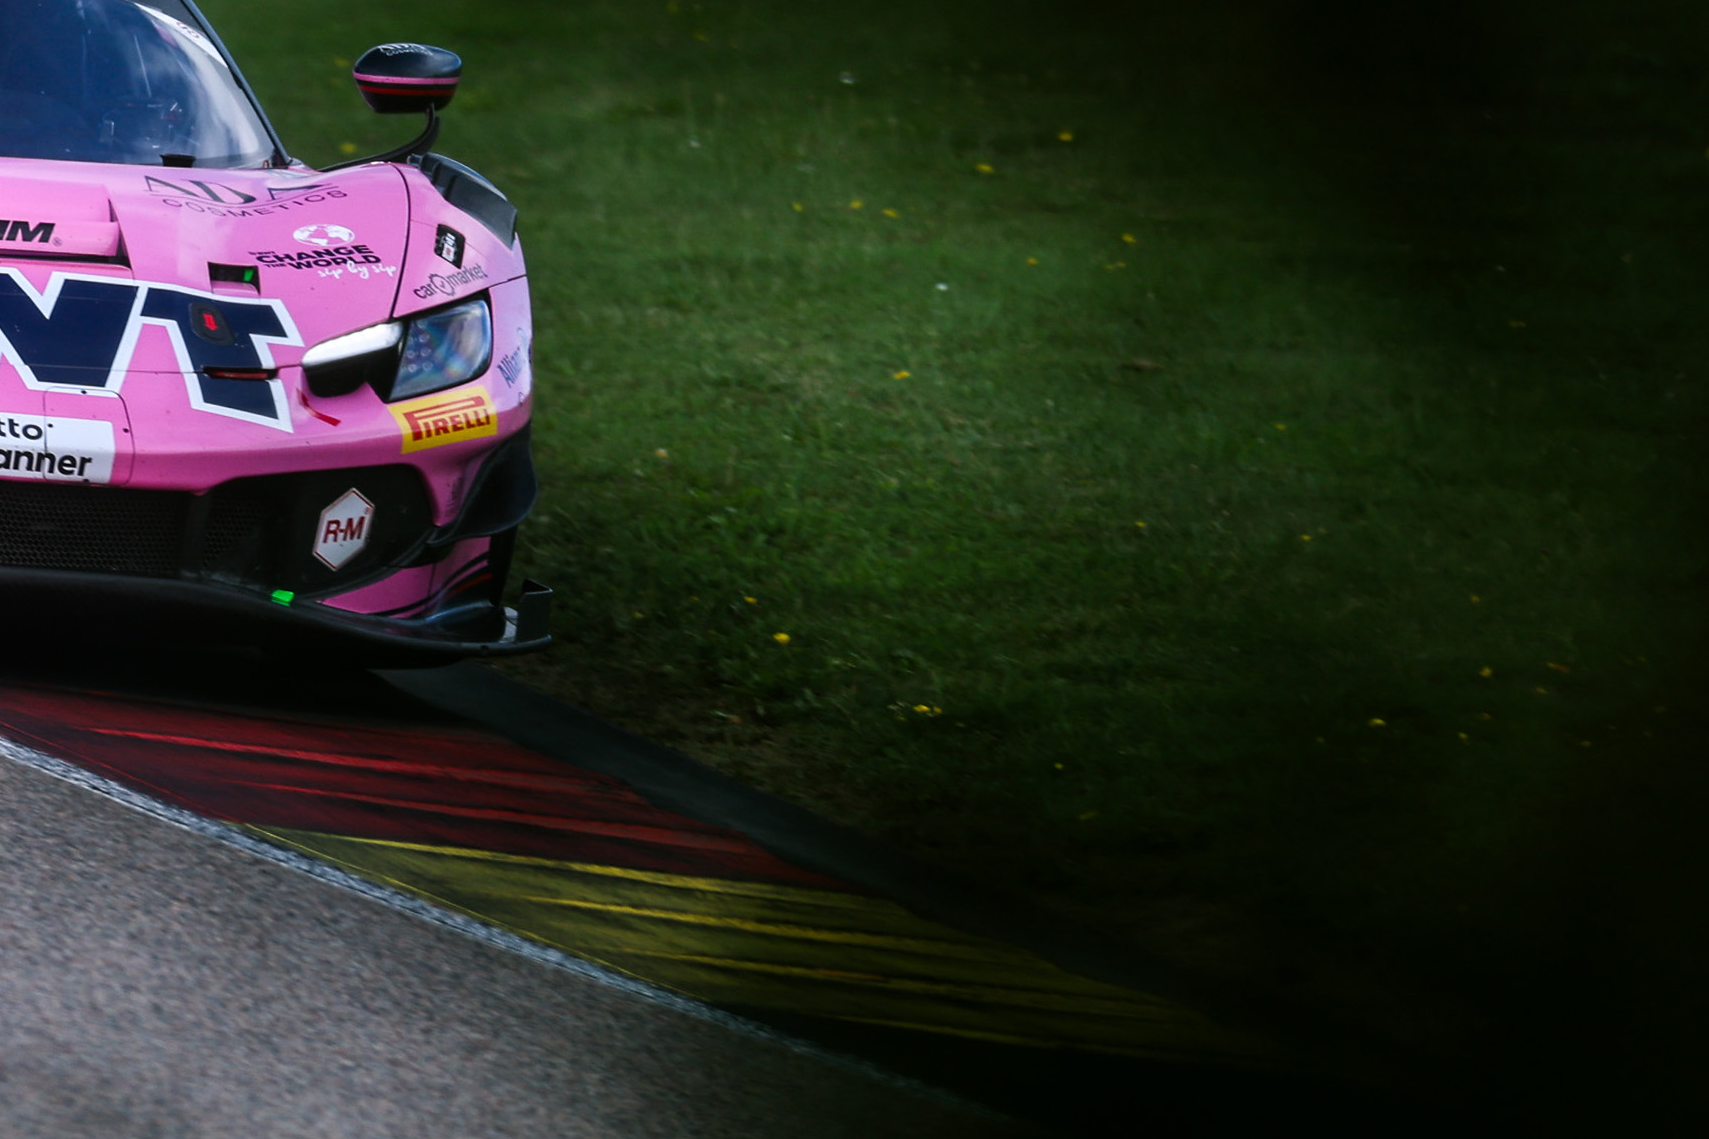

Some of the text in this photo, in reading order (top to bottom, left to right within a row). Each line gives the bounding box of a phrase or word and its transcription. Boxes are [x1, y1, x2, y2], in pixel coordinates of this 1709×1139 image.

[256, 244, 374, 263] CHANGE
[288, 255, 381, 270] WORLD
[403, 396, 491, 441] PIRELLI
[323, 516, 366, 544] R-M
